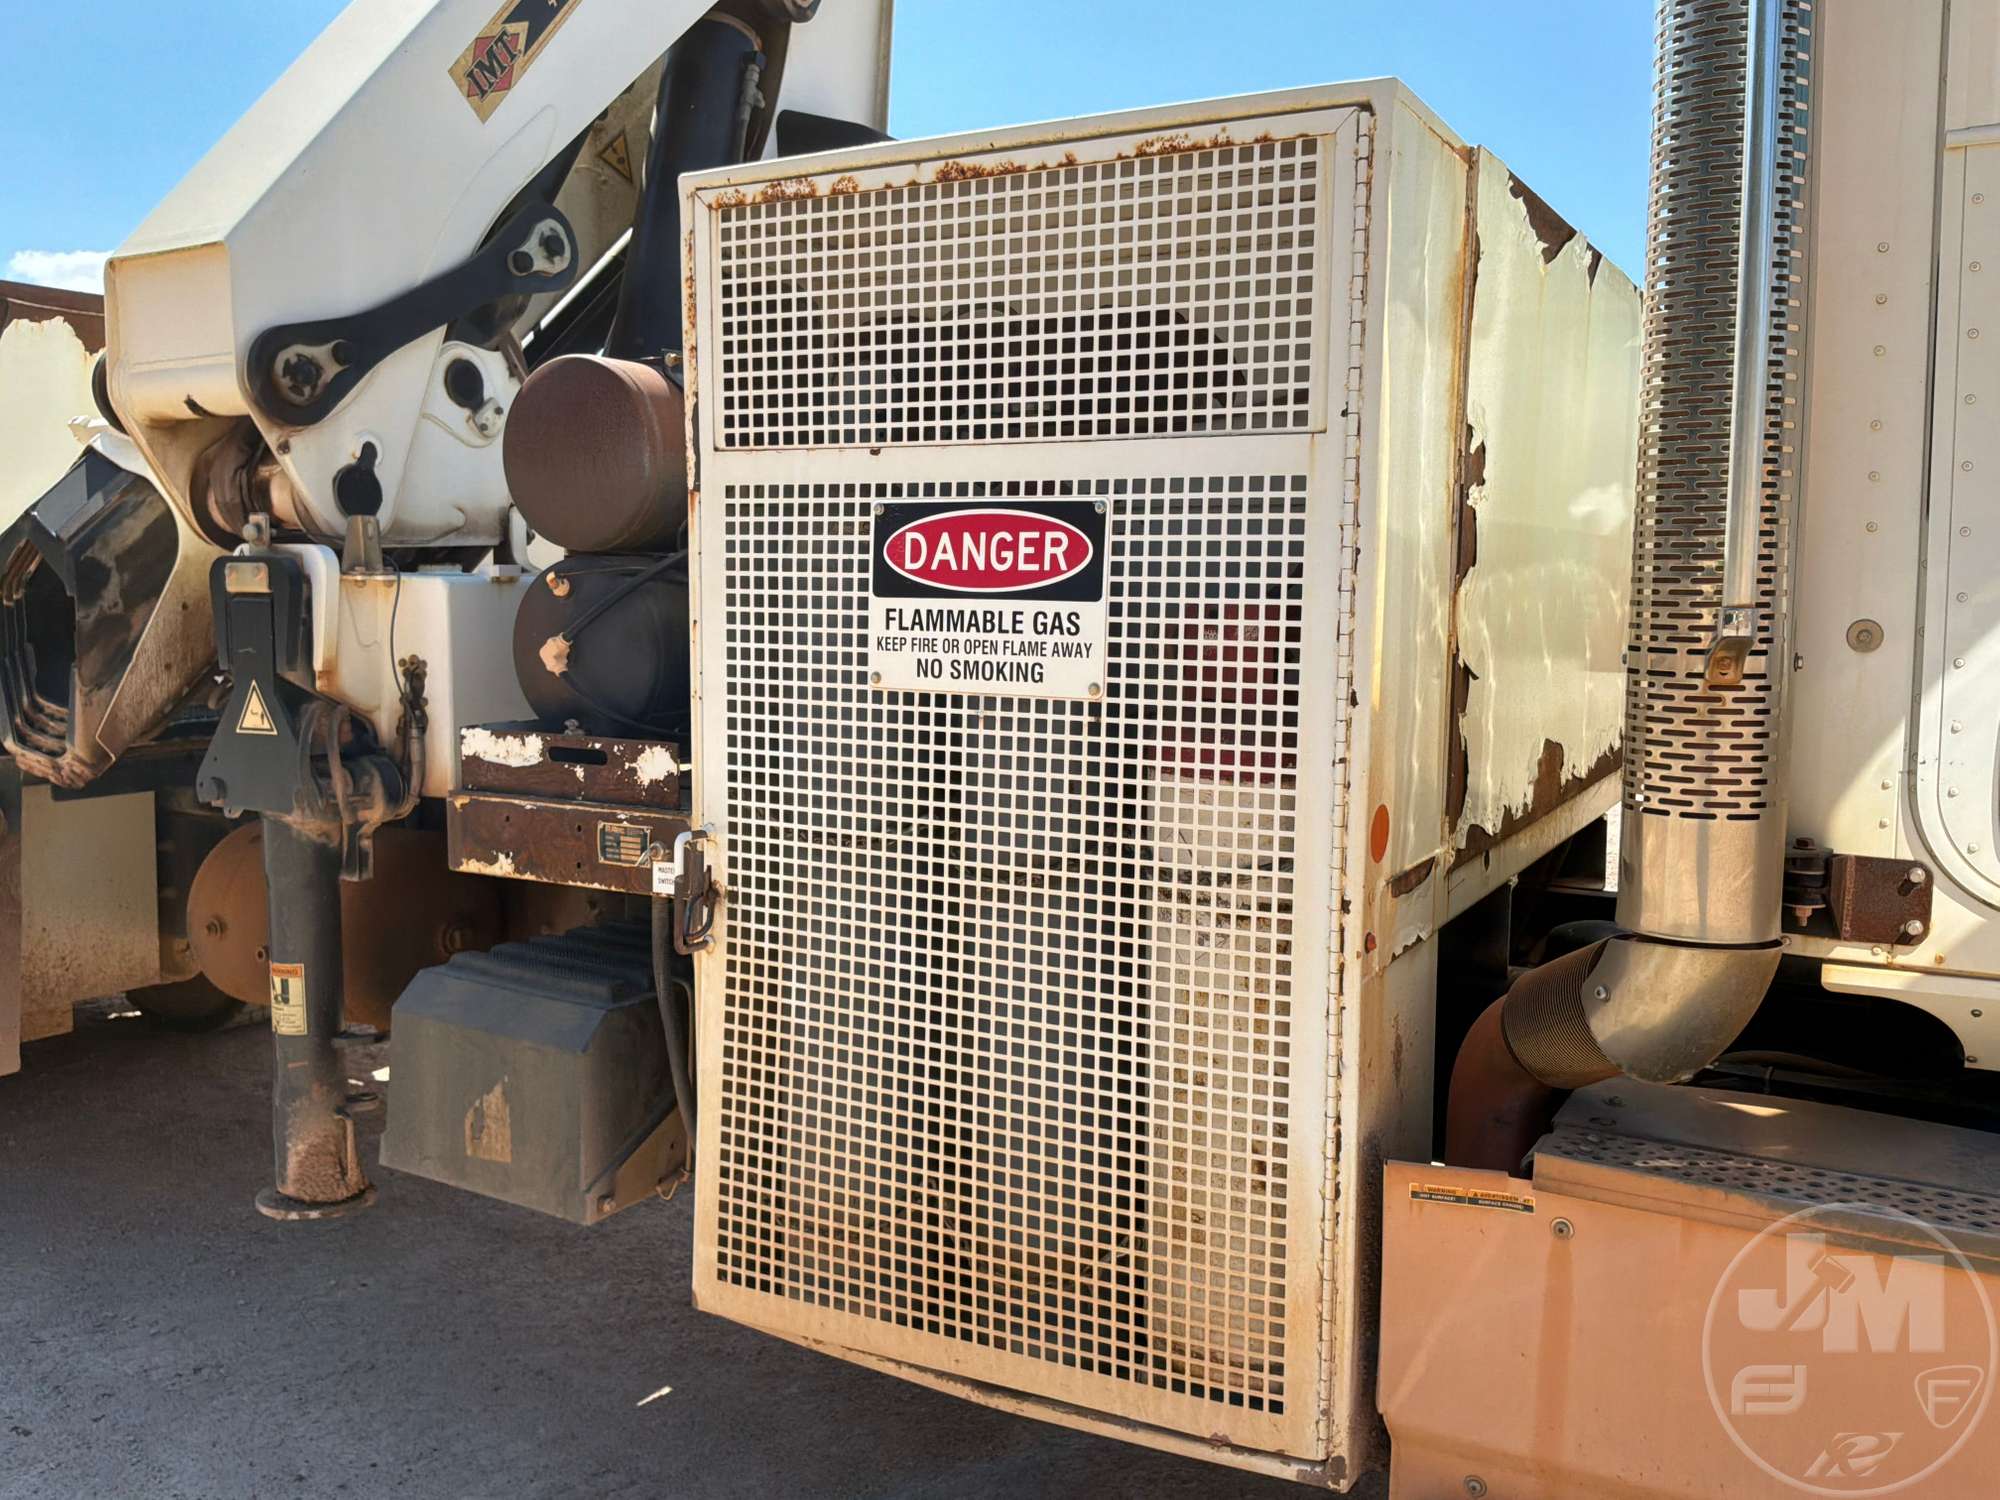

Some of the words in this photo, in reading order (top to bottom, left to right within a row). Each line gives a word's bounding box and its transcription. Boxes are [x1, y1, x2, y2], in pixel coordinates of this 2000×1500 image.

[464, 27, 522, 103] IMT
[904, 531, 1069, 571] DANGER
[885, 608, 1024, 634] FLAMMABLE
[1032, 611, 1081, 636] GAS
[876, 636, 907, 652] KEEP
[911, 637, 938, 653] FIRE
[942, 638, 960, 654] OR
[964, 639, 998, 656] OPEN
[1003, 640, 1047, 657] FLAME
[1051, 641, 1093, 659] AWAY
[916, 658, 943, 679] NO
[950, 659, 1044, 683] SMOKING
